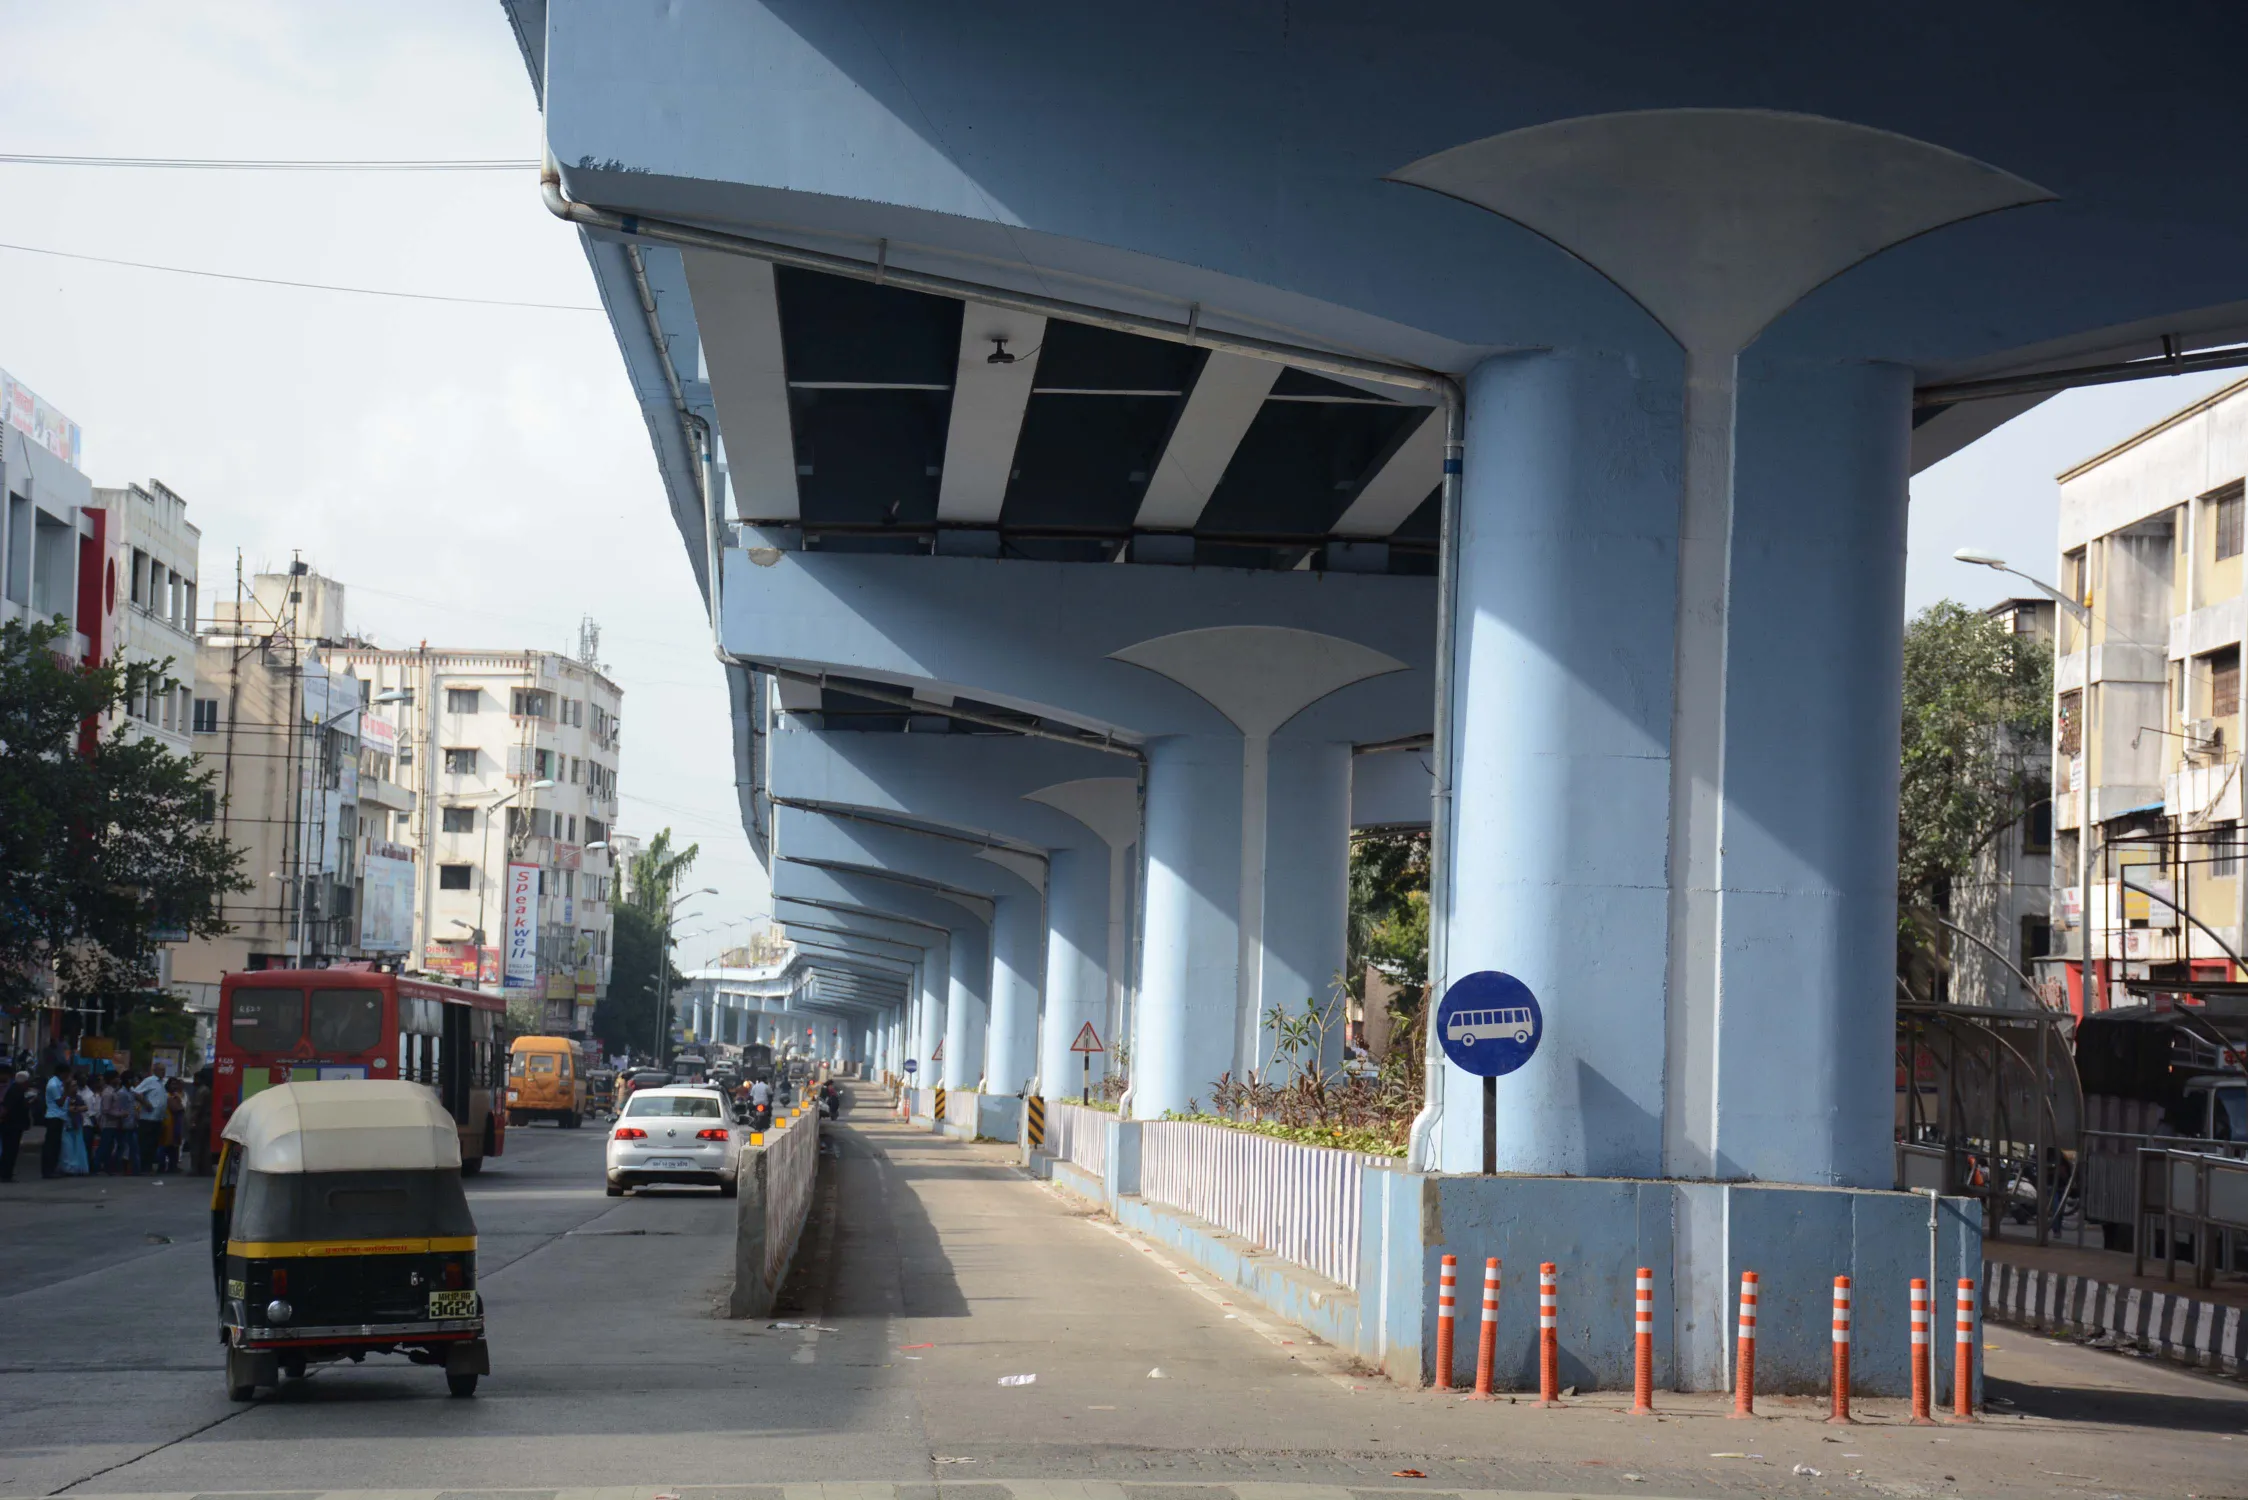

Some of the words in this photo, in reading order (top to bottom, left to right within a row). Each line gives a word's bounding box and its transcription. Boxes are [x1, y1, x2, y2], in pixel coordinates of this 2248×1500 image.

[512, 871, 530, 959] Speakwell
[425, 945, 456, 953] DISHA
[431, 1300, 475, 1317] 3424
